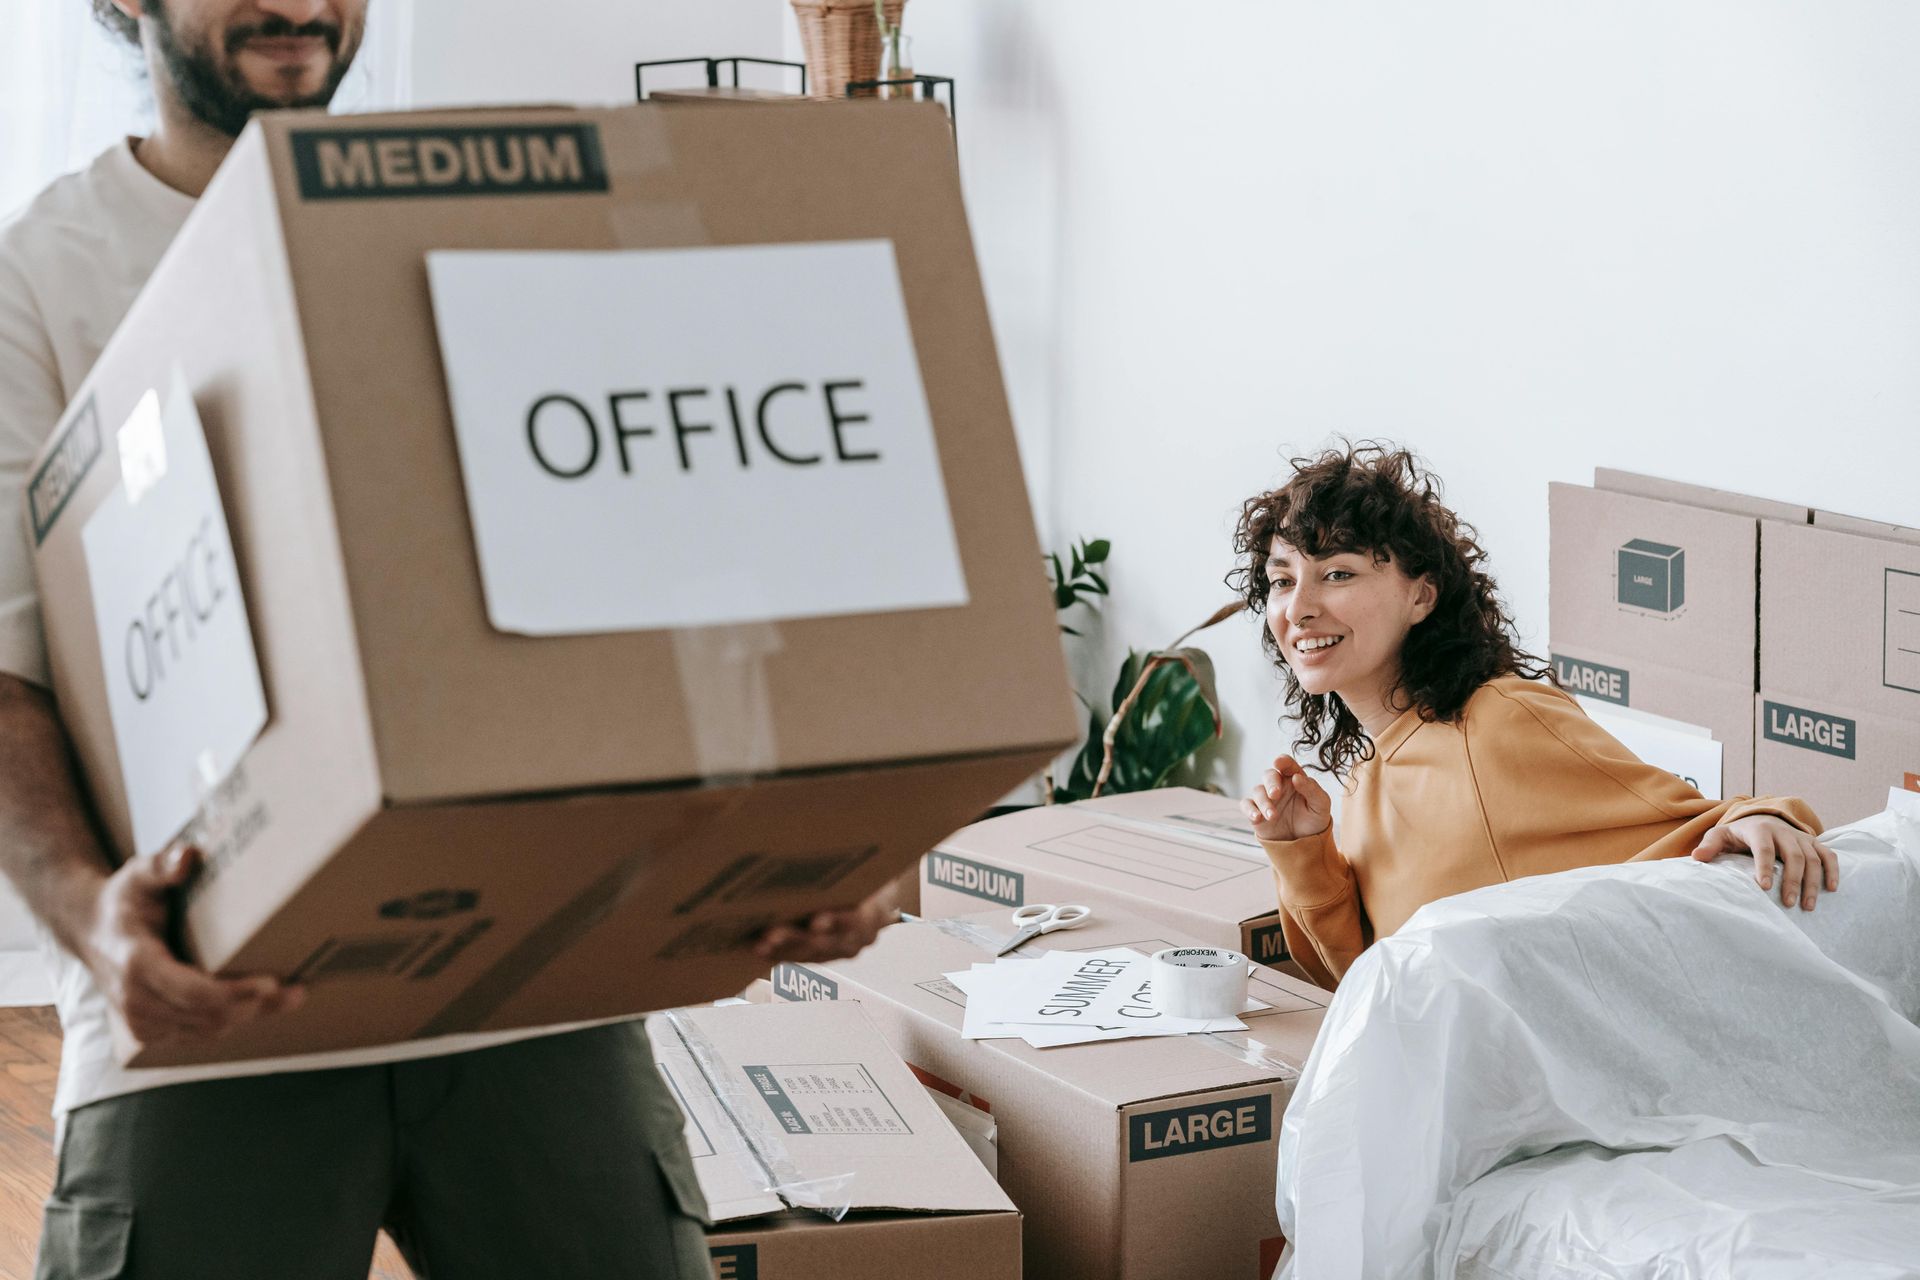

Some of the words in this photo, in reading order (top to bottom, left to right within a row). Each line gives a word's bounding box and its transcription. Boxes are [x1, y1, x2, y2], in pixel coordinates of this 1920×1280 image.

[316, 133, 584, 190] MEDIUM
[525, 377, 882, 481] OFFICE
[1633, 574, 1653, 587] LARGE
[125, 516, 229, 702] OFFICE
[1557, 661, 1622, 699] LARGE
[1771, 709, 1846, 750] LARGE
[934, 856, 1017, 902] MEDIUM
[779, 964, 832, 1001] LARGE
[1038, 958, 1131, 1017] SUMMER
[1143, 1106, 1257, 1150] LARGE
